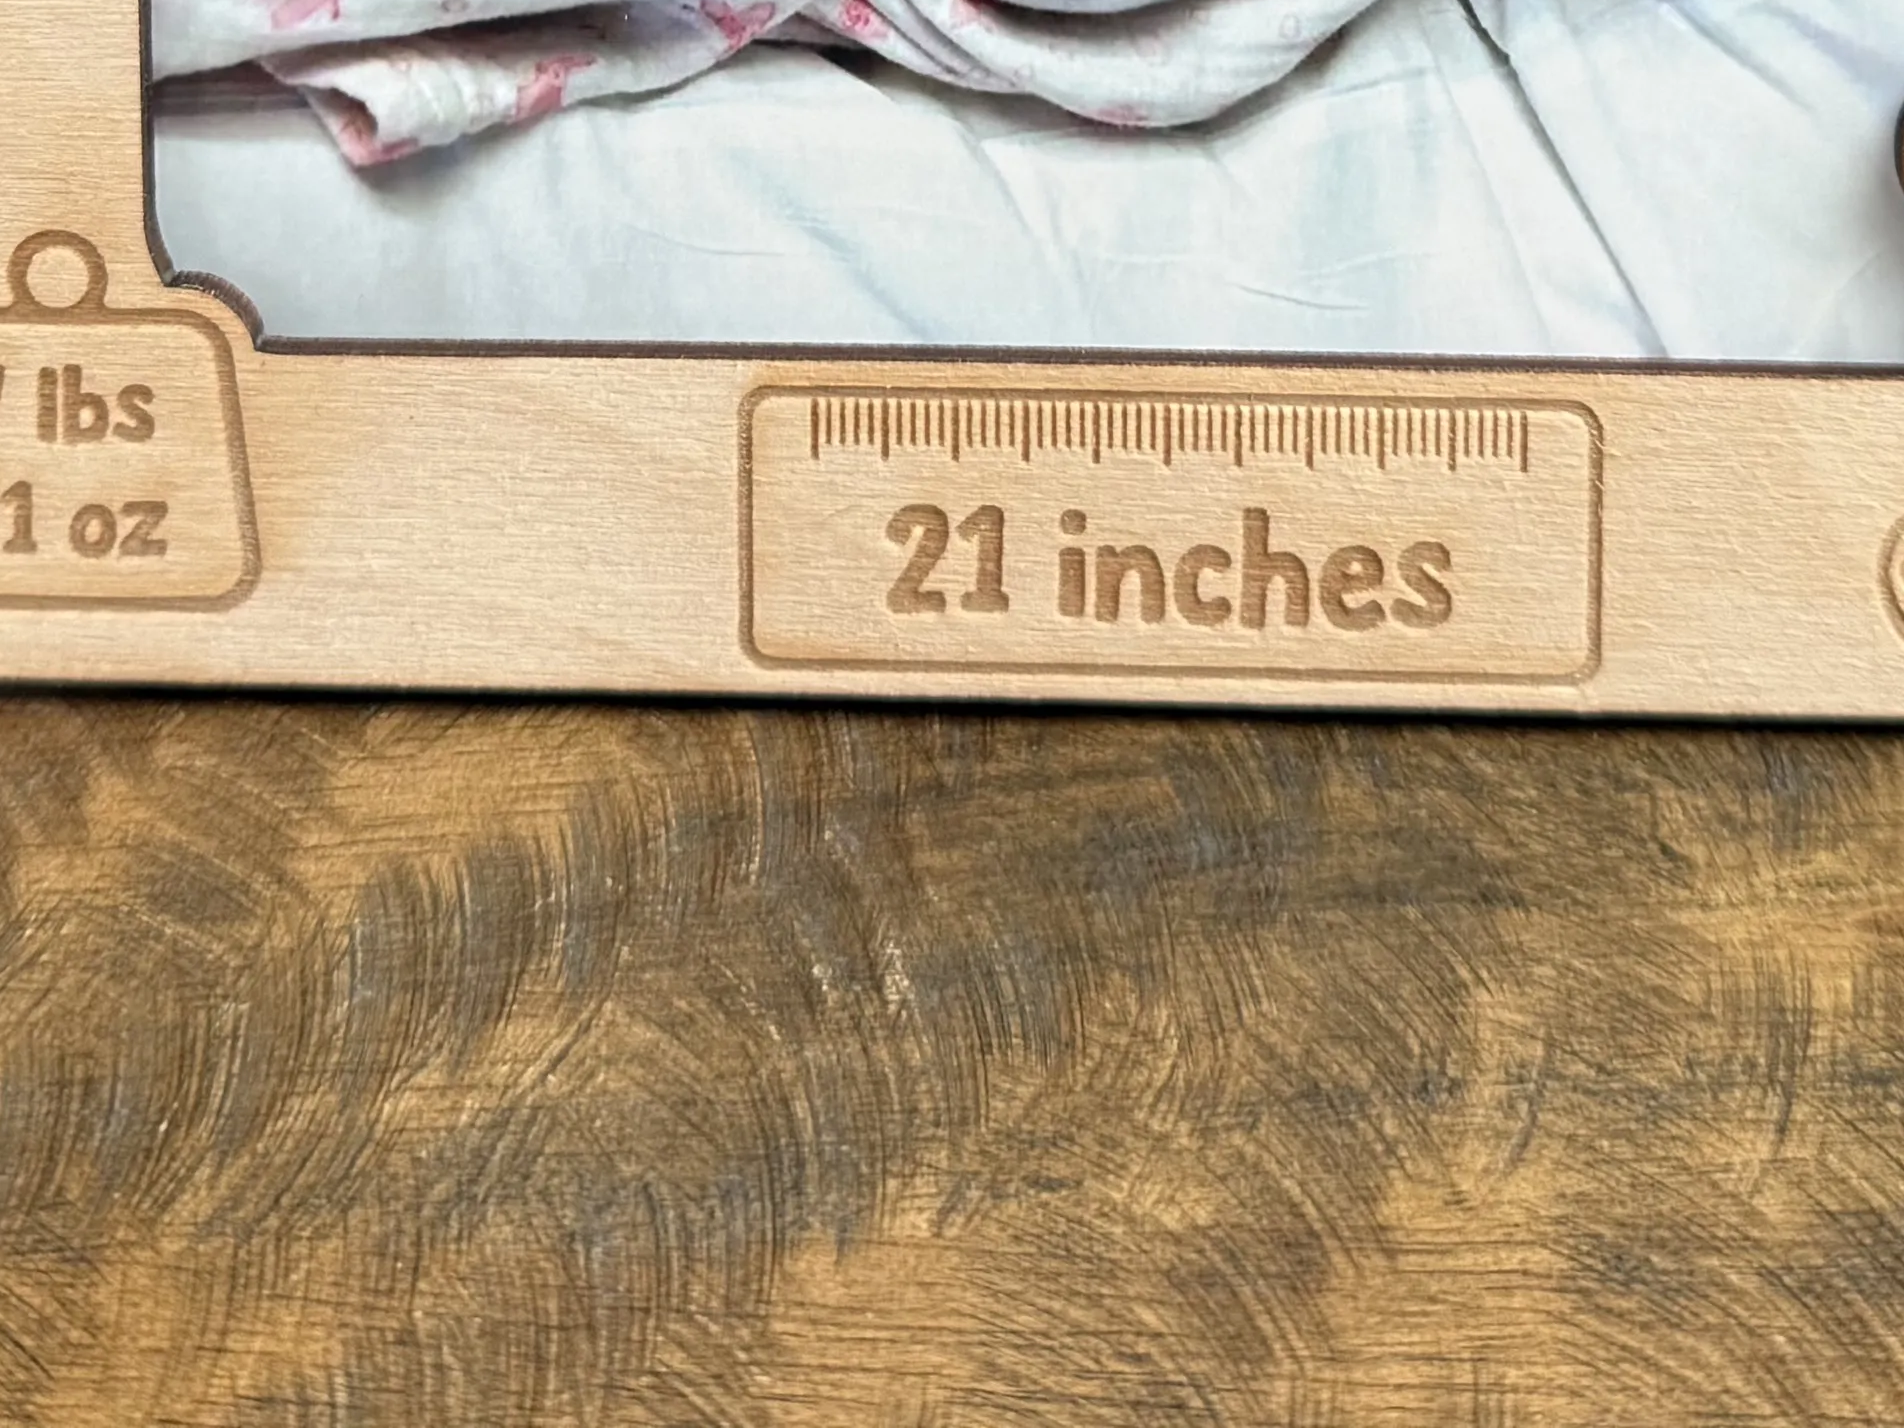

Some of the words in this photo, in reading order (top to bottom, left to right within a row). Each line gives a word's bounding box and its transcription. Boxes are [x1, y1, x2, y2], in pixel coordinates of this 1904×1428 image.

[36, 363, 156, 444] lbs
[68, 500, 169, 558] oz
[886, 503, 1010, 615] 21
[1057, 507, 1453, 632] inches
